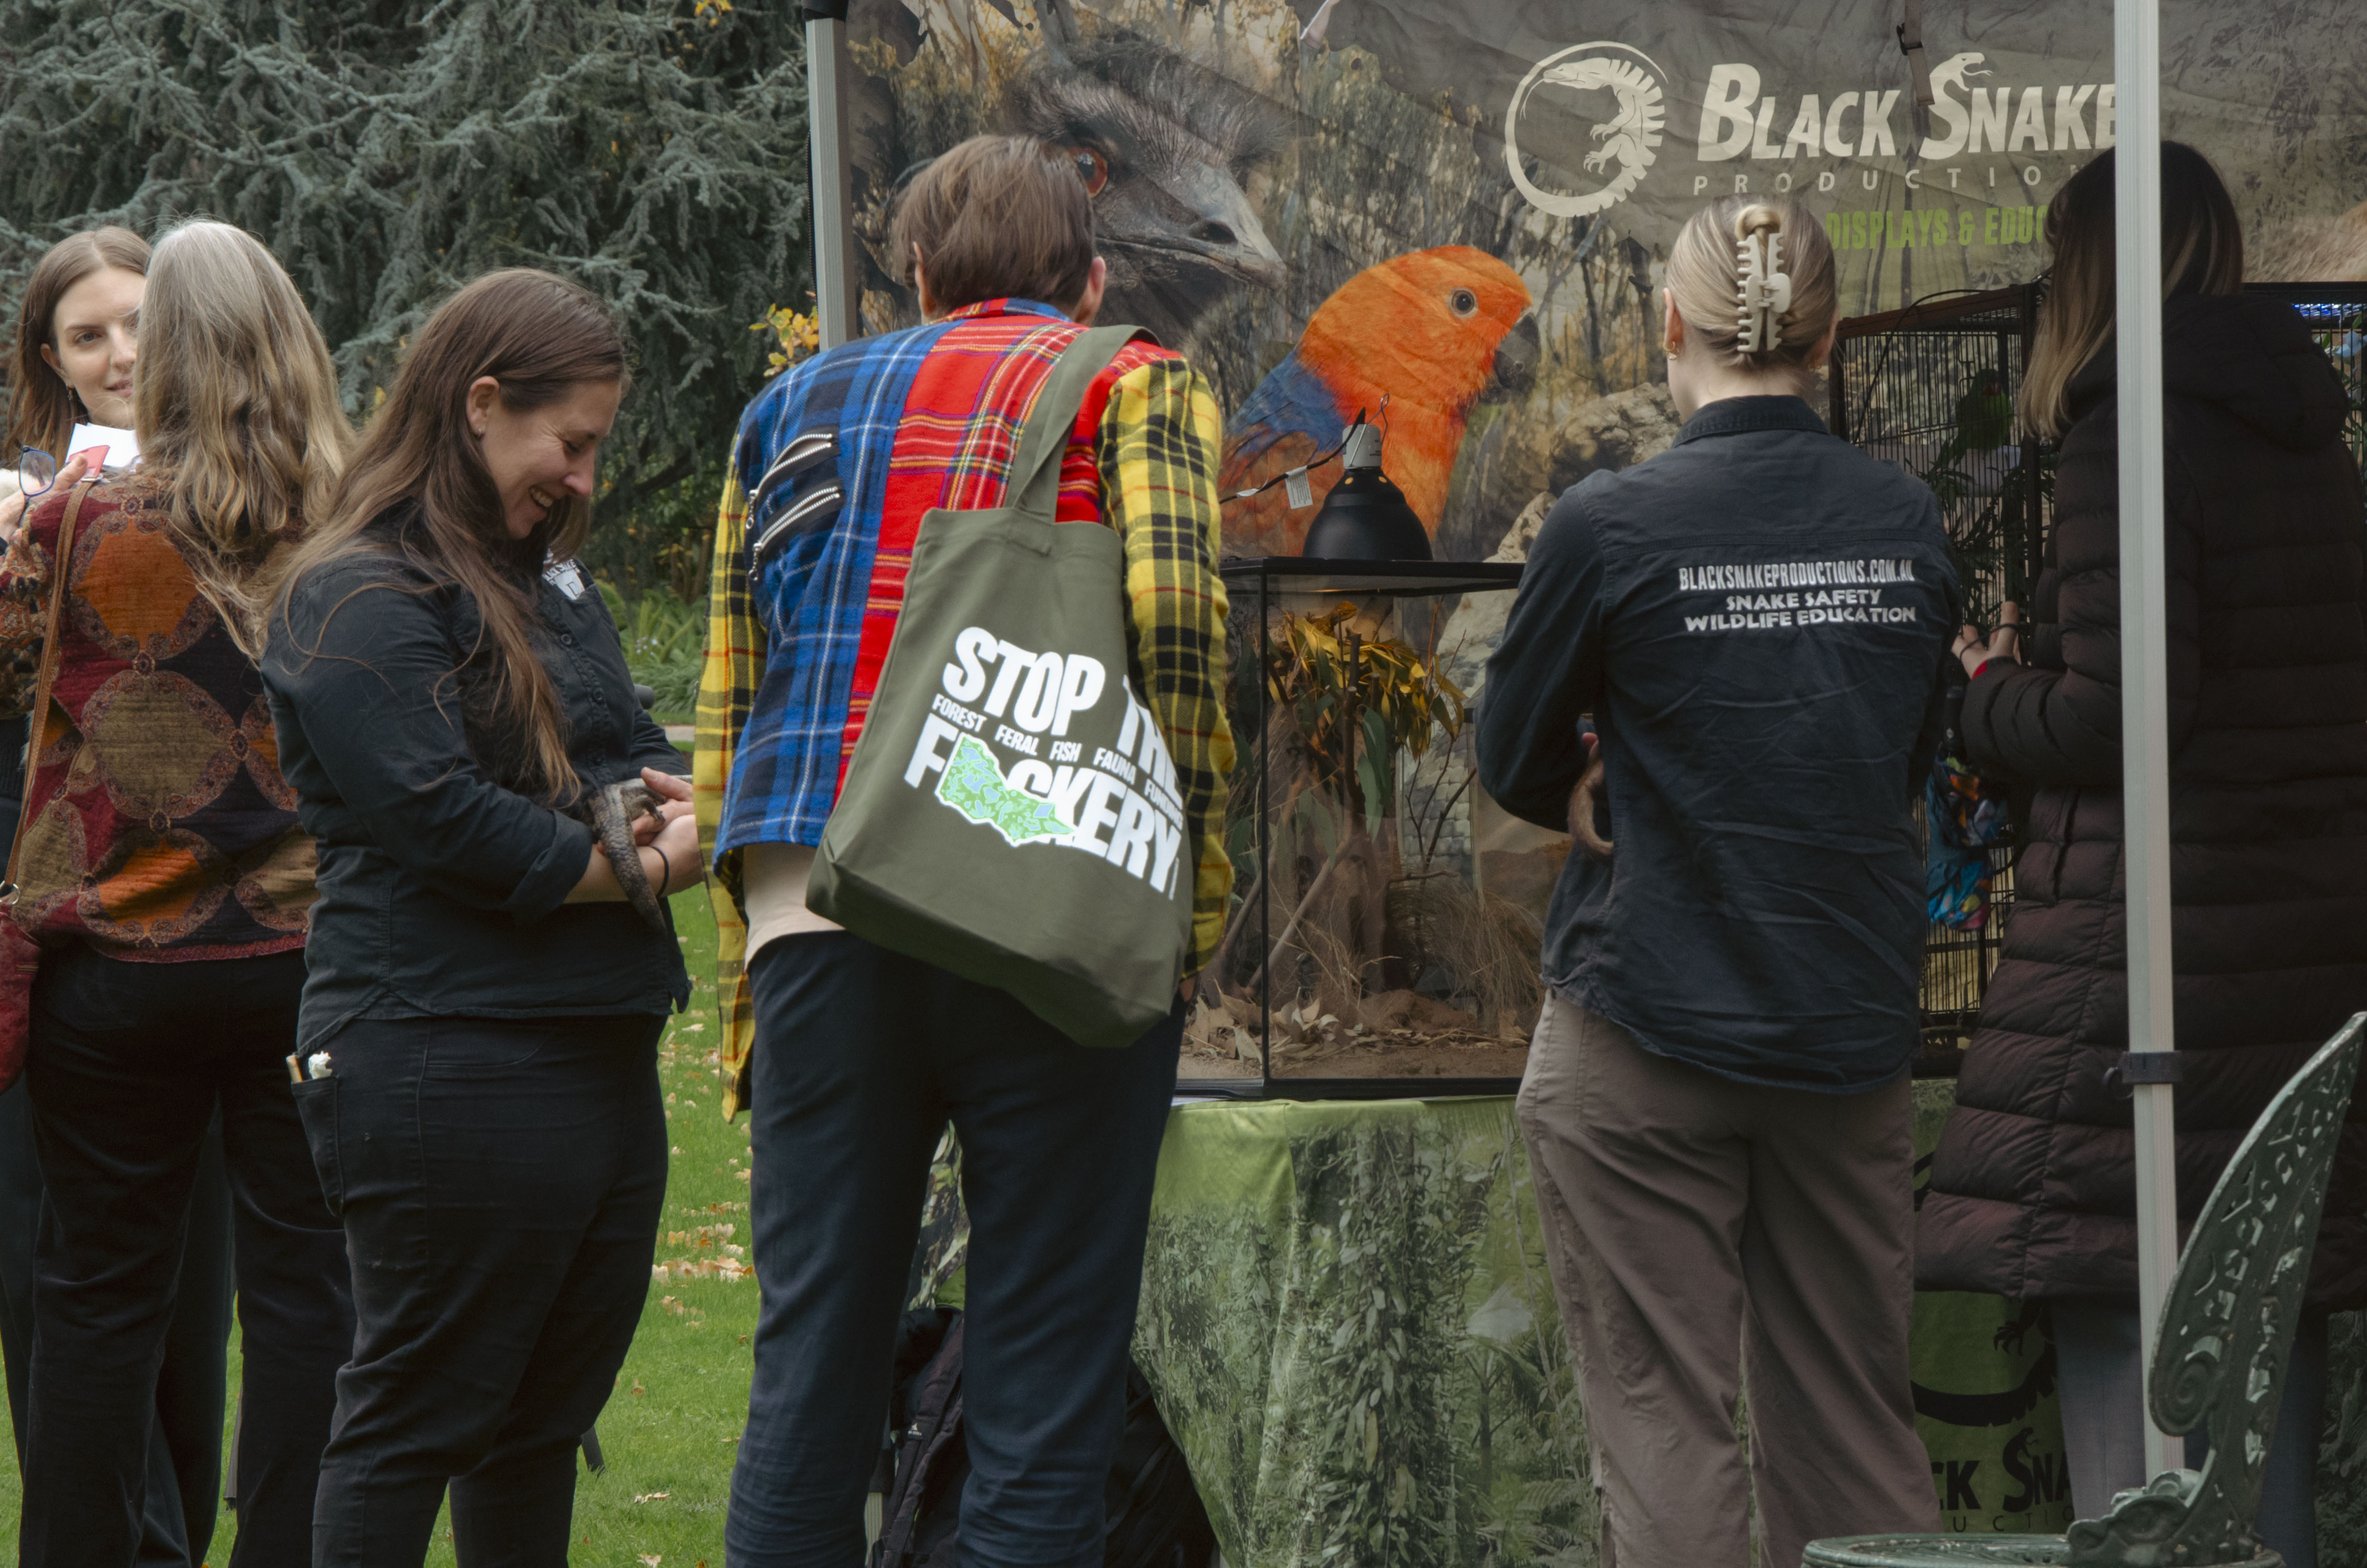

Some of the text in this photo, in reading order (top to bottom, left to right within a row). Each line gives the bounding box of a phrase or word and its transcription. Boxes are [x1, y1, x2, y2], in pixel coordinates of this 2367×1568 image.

[1697, 52, 2116, 162] BLACK SNAKE
[1693, 164, 2085, 196] PRODUCTIO
[1825, 208, 1948, 250] DISPLAYS
[1958, 211, 1976, 245] &
[1678, 559, 1915, 591] BLACKSNAKEPRODUCTIONS.COM.AU
[1684, 606, 1916, 632] WILDLIFE EDUCATION
[1726, 589, 1882, 611] SNAKE SAFETY
[942, 626, 1106, 736] STOP
[931, 693, 987, 732] FOREST
[994, 724, 1039, 756] FERAL
[1049, 741, 1082, 763] FISH
[1092, 747, 1137, 785] FAUNA
[904, 712, 1182, 893] FCKERY
